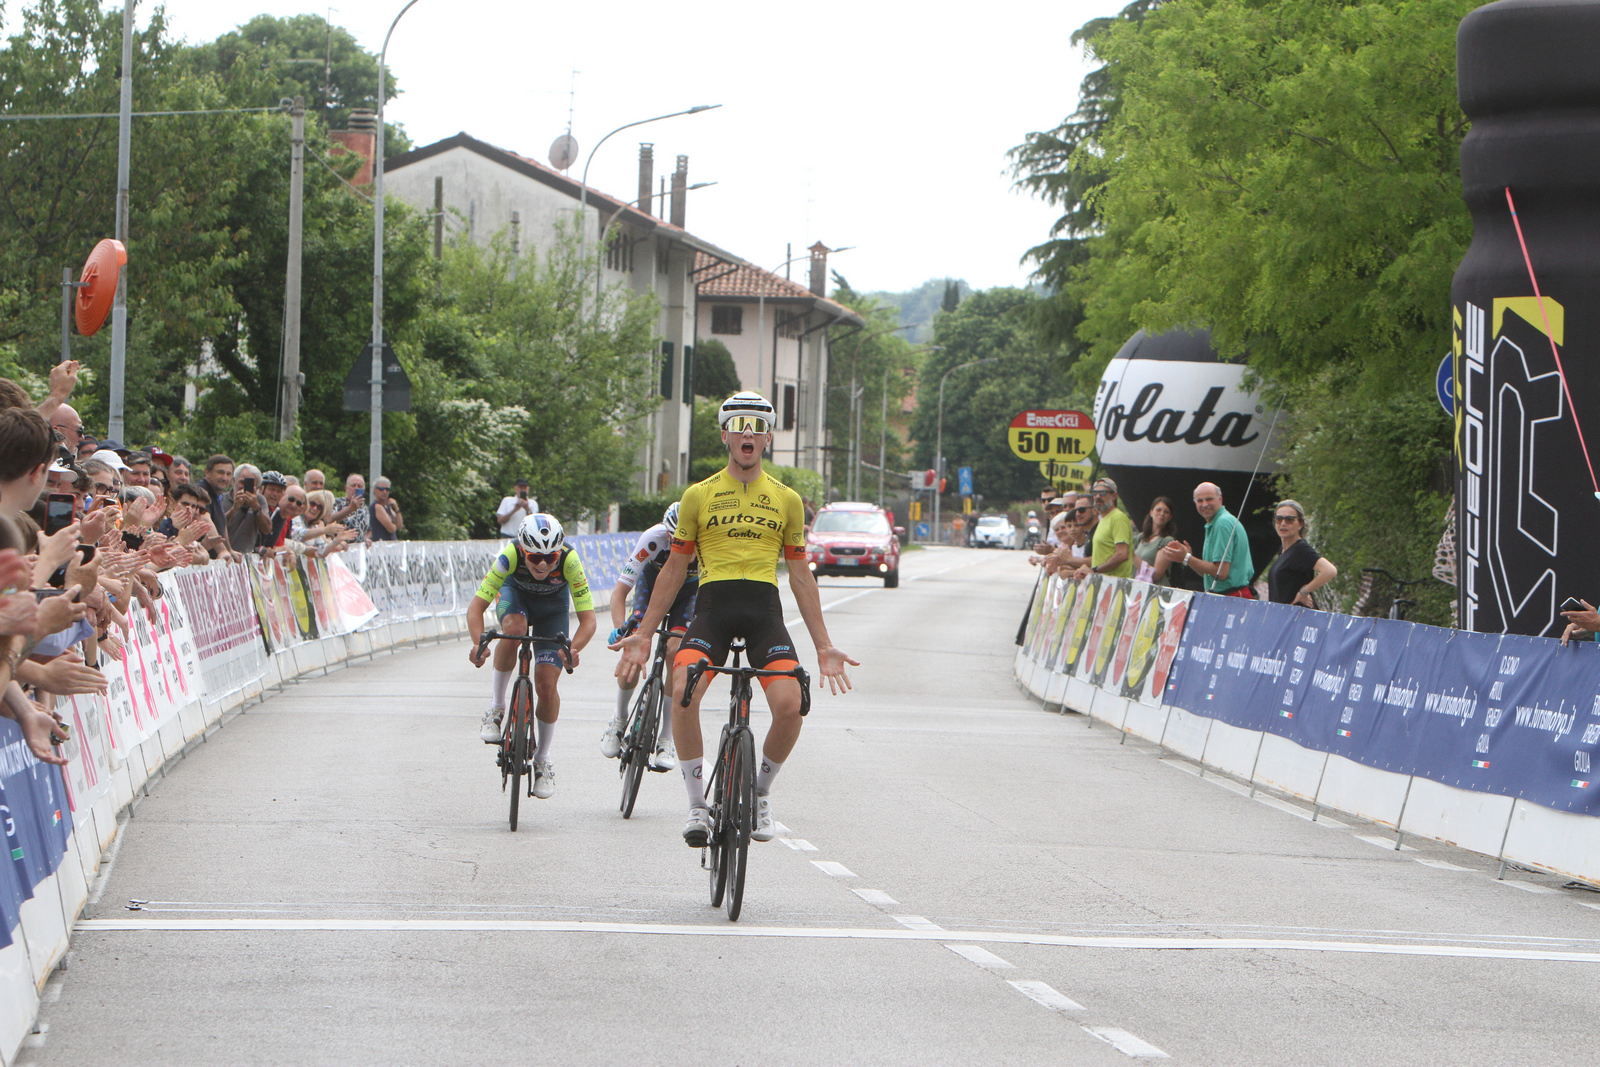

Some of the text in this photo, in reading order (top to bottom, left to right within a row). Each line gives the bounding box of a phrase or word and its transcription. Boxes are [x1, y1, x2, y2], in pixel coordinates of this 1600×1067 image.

[1017, 431, 1086, 455] 50 Mt.
[1466, 301, 1485, 632] RACEONE
[706, 513, 783, 533] Autozai
[727, 528, 762, 540] Contri
[1514, 699, 1577, 743] www.turismofvg.it
